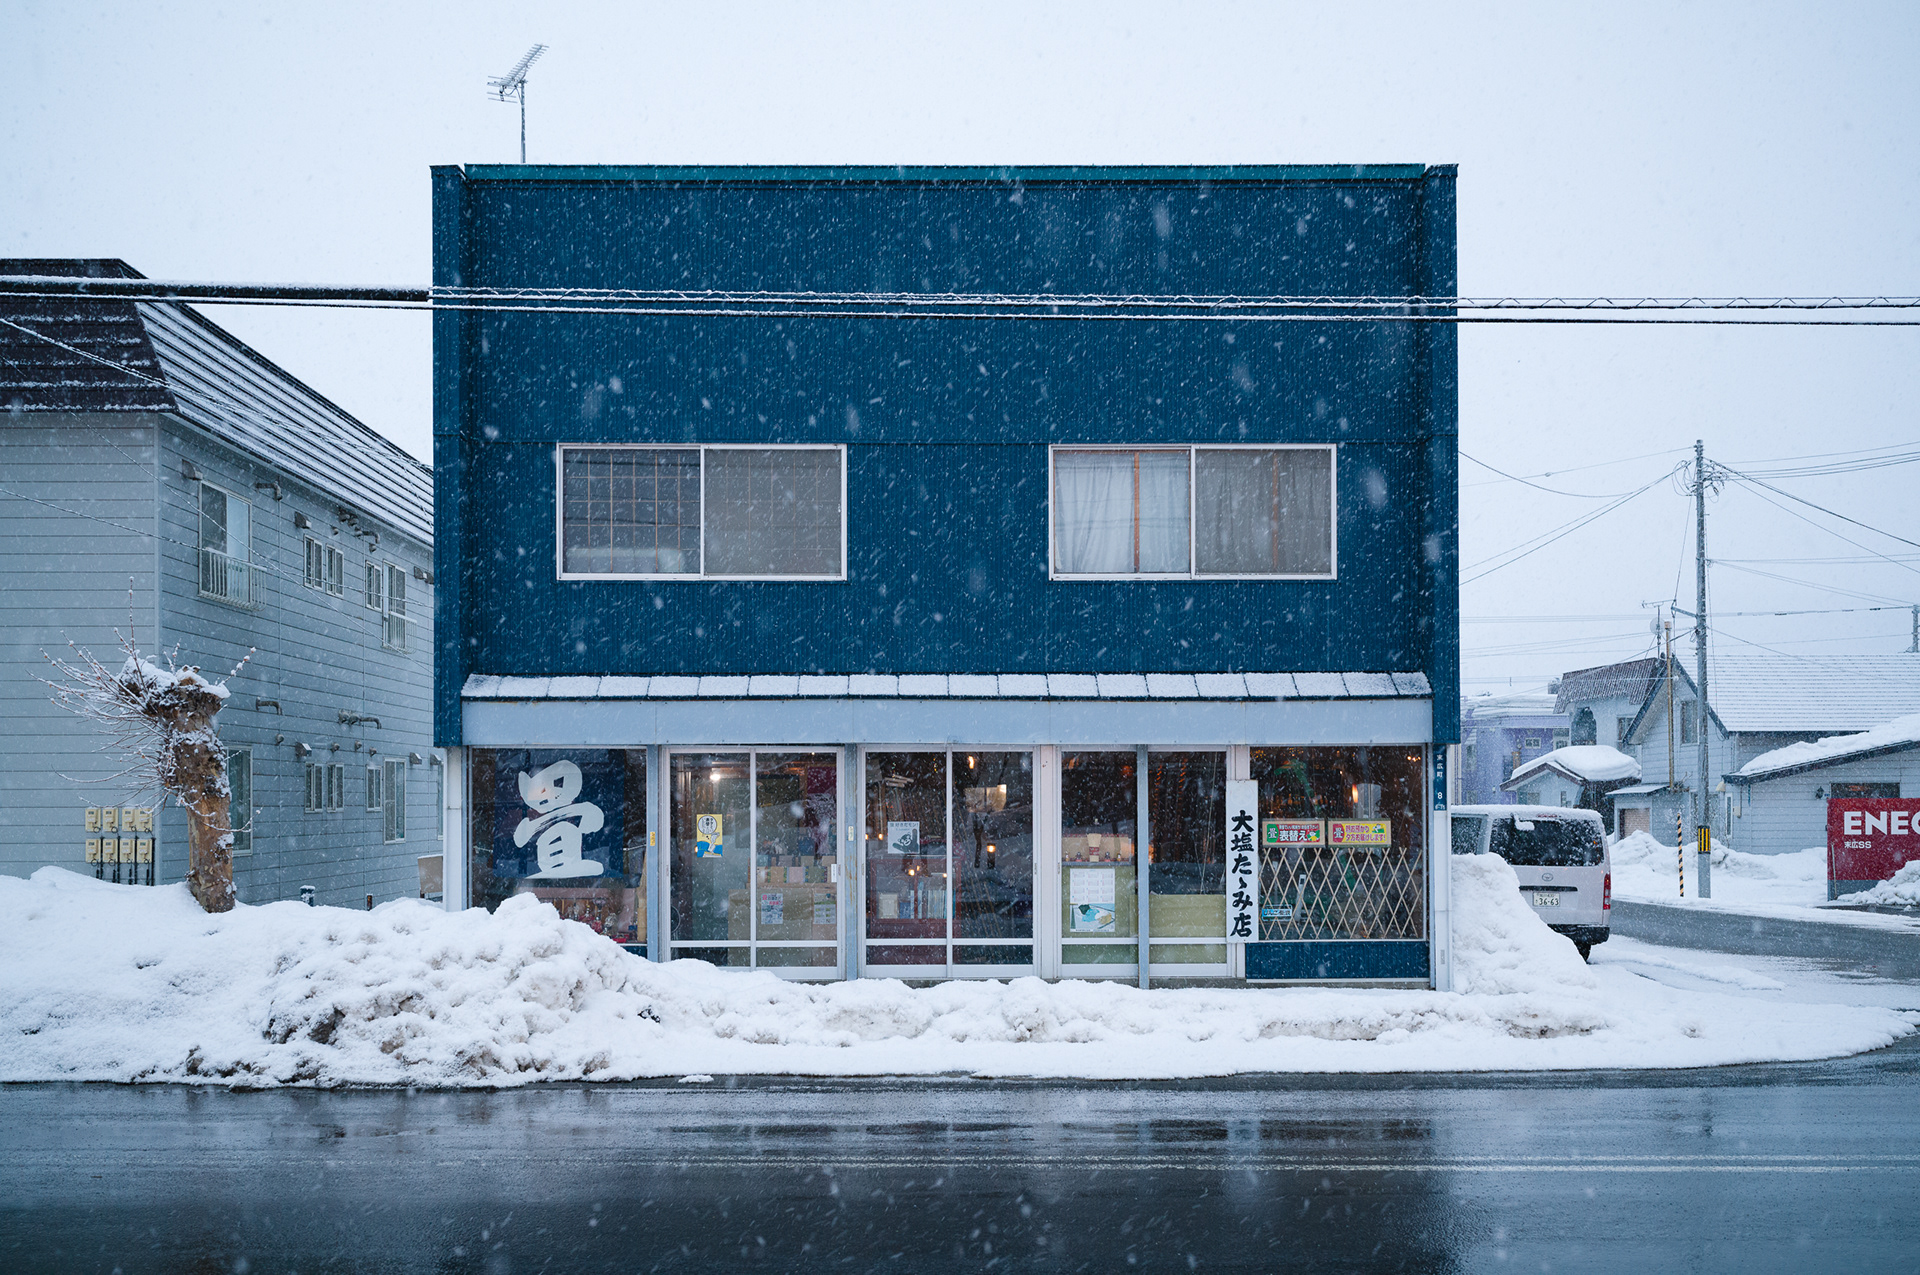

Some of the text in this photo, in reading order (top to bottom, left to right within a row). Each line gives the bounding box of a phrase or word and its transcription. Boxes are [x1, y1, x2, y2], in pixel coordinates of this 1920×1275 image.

[1437, 791, 1443, 800] 8
[513, 759, 604, 879] 畳
[1279, 830, 1308, 842] 表替え
